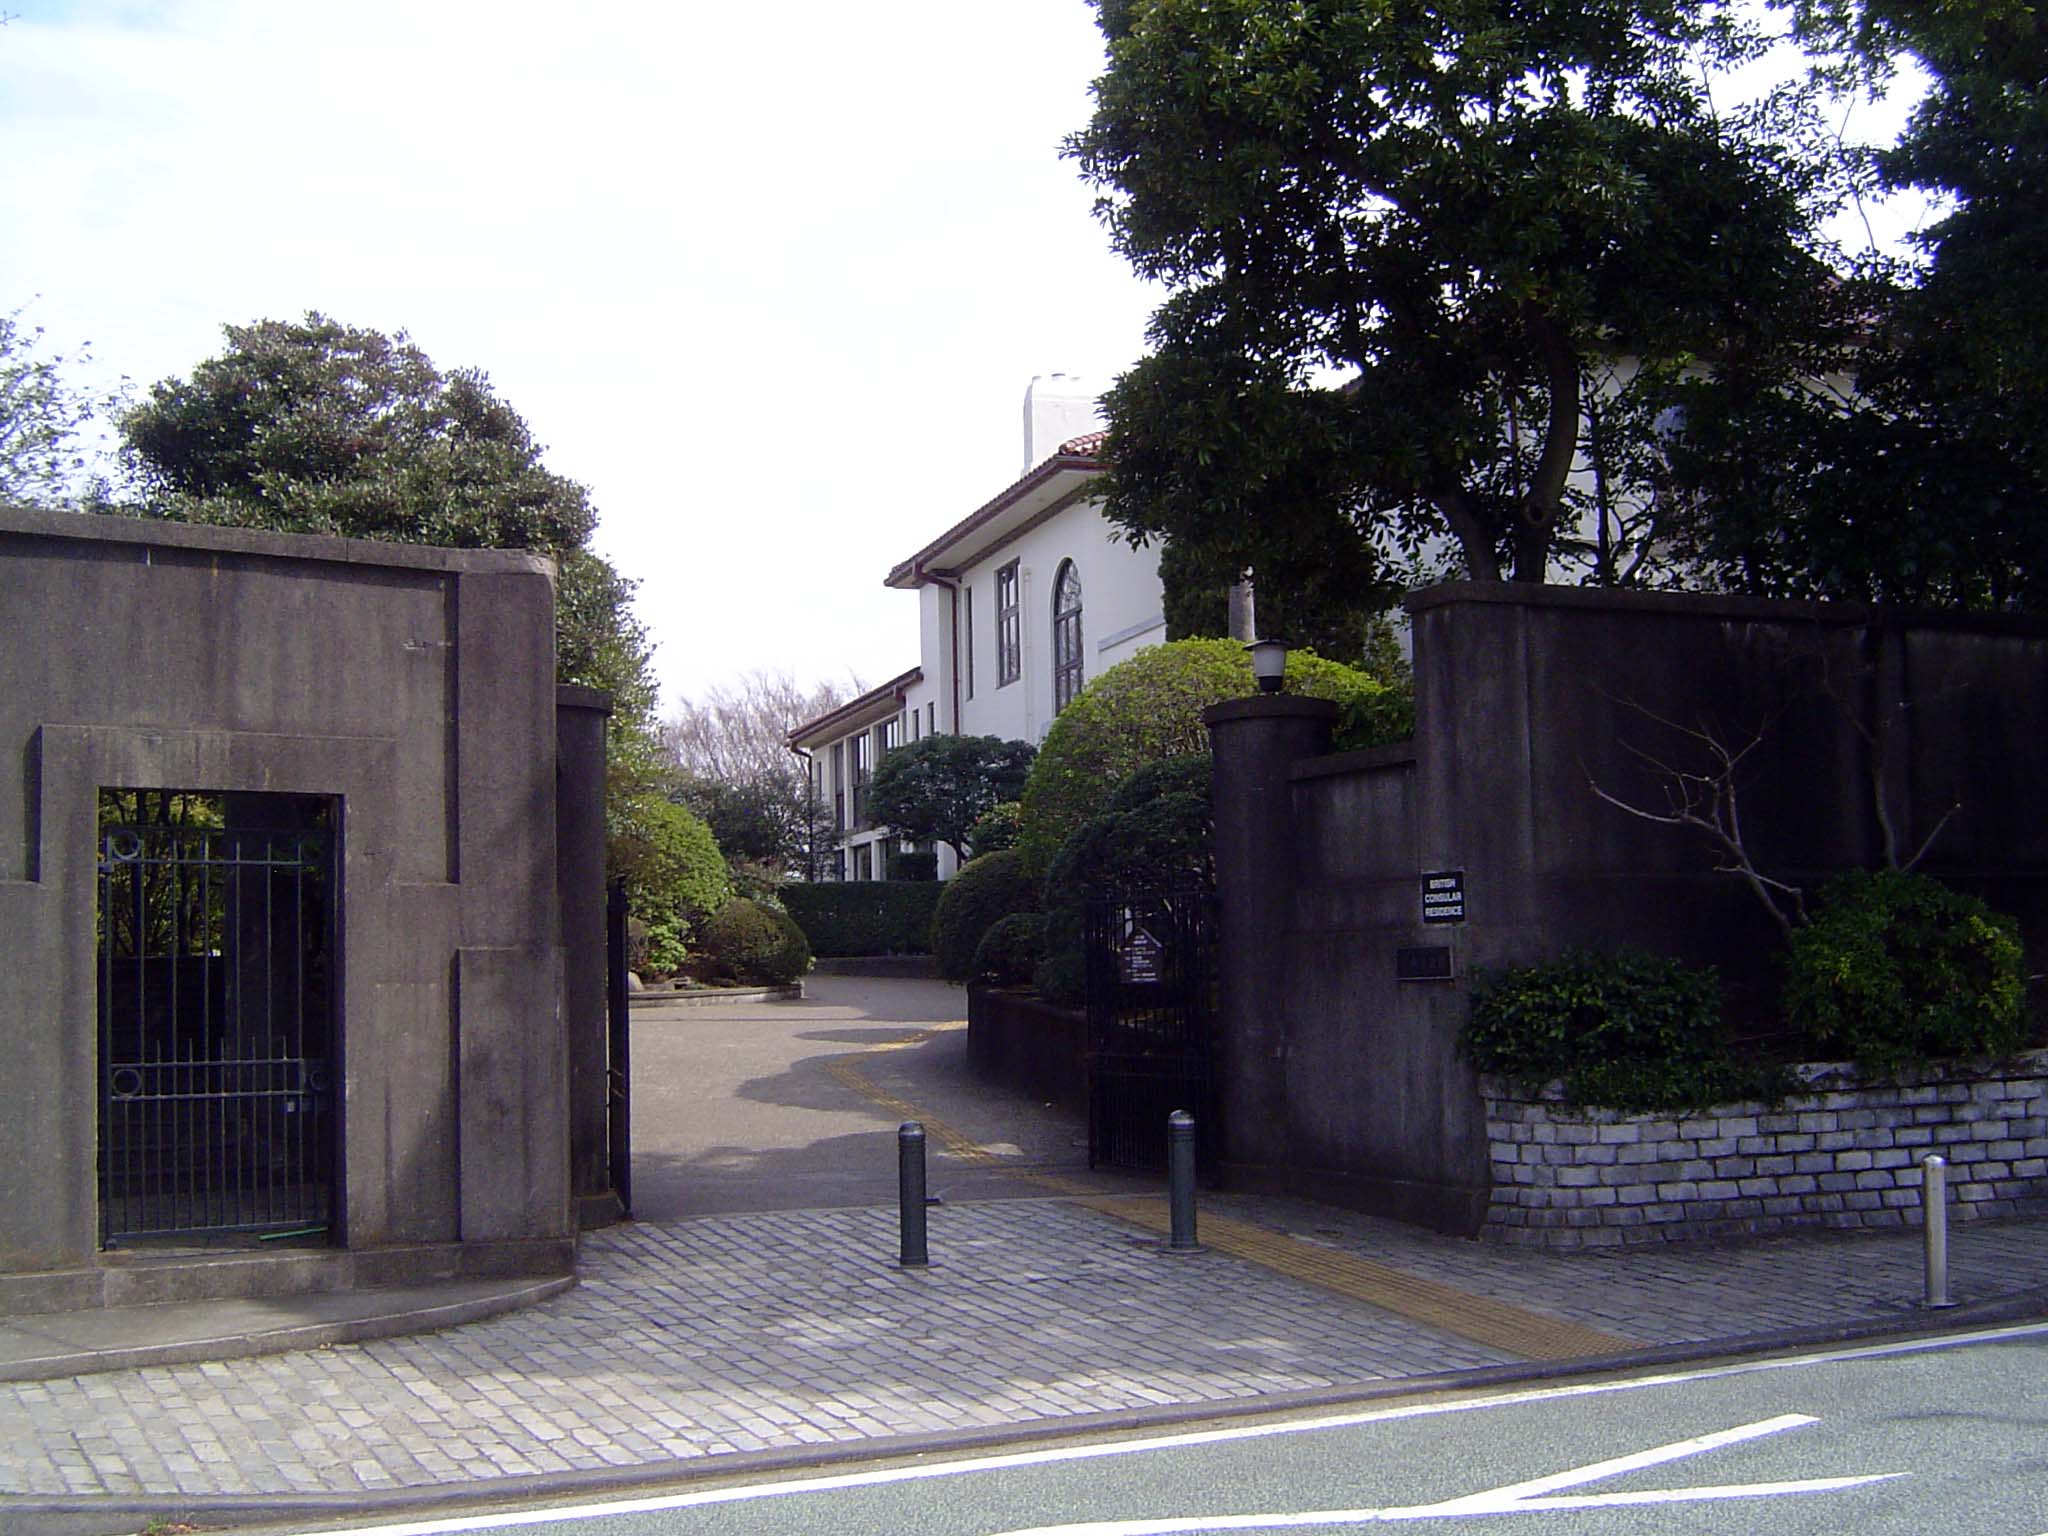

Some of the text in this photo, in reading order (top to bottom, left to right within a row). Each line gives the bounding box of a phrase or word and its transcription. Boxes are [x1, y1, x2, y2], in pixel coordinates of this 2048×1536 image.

[1429, 879, 1456, 889] BRITISH
[1424, 891, 1462, 903] CONSULAR
[1424, 905, 1463, 917] RESIDENCE
